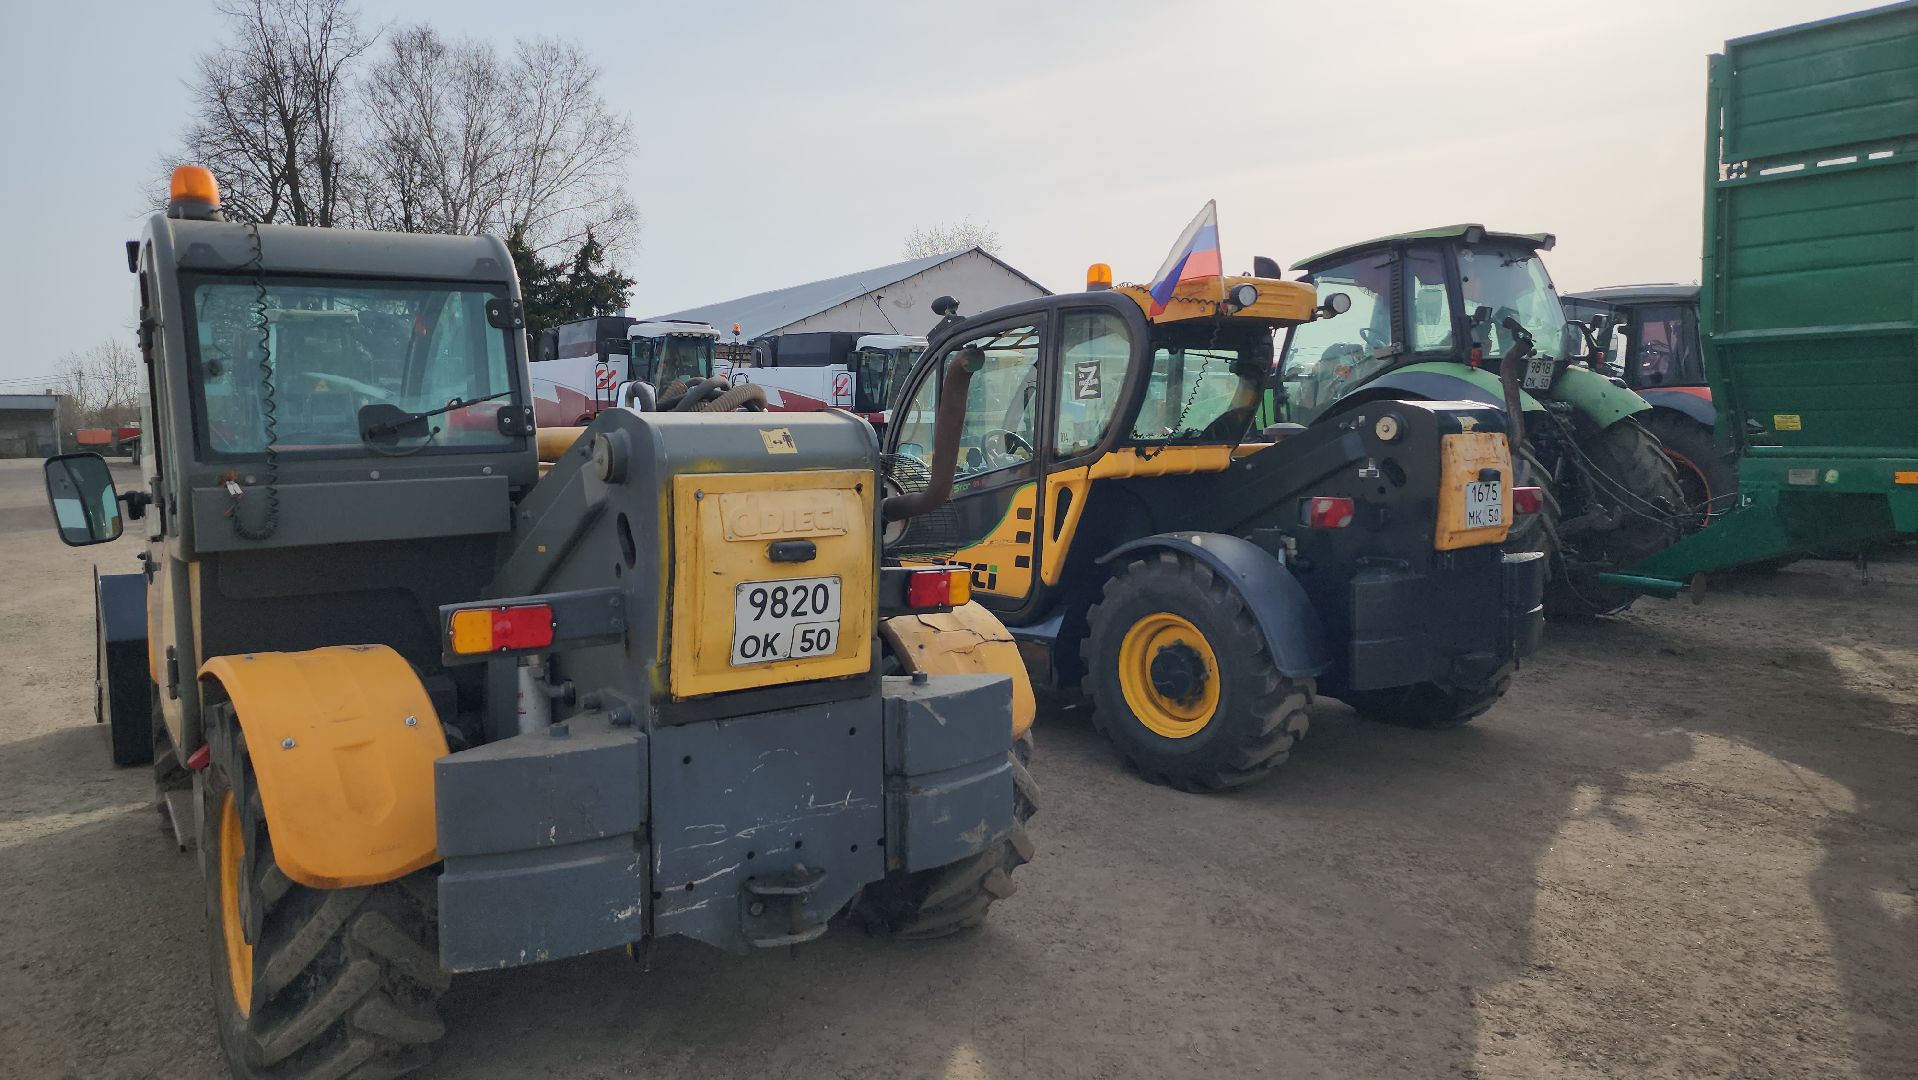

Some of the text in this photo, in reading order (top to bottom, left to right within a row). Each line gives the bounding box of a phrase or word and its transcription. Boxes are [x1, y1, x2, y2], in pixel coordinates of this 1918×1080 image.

[1531, 361, 1551, 374] 9818
[1471, 483, 1498, 503] 1675
[1468, 508, 1499, 526] МК 50
[749, 583, 830, 622] 9820
[739, 627, 831, 659] ОК 50
